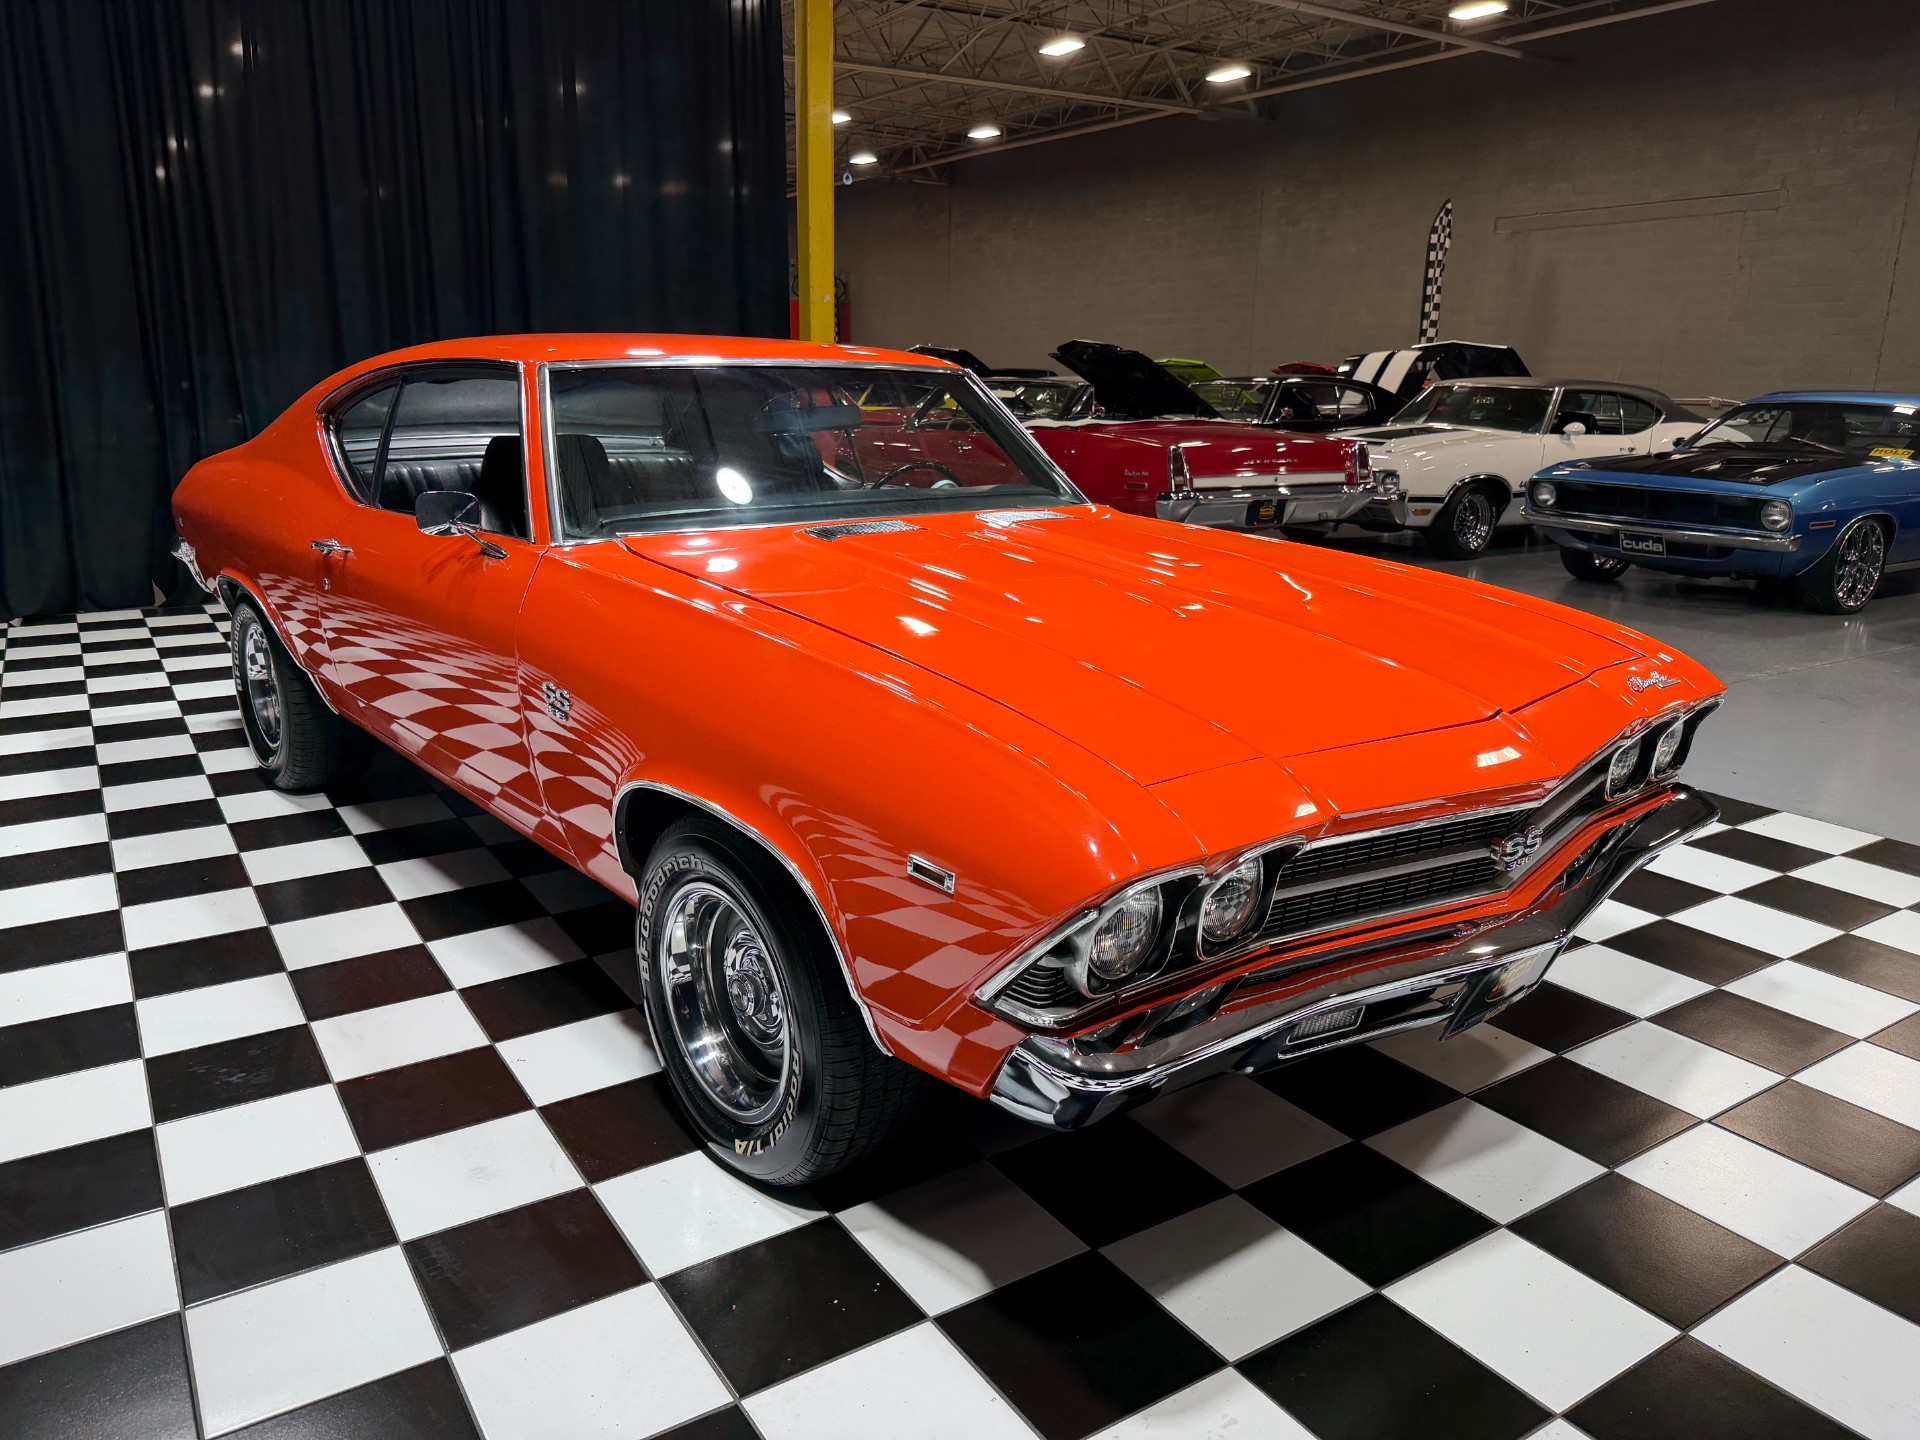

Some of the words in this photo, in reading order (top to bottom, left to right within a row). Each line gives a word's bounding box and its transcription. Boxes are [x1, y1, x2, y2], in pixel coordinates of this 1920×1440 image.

[541, 681, 570, 712] SS
[1501, 827, 1544, 863] SS
[639, 853, 704, 982] BFGoodrich
[769, 1047, 801, 1148] Radial
[734, 1138, 764, 1157] T/A
